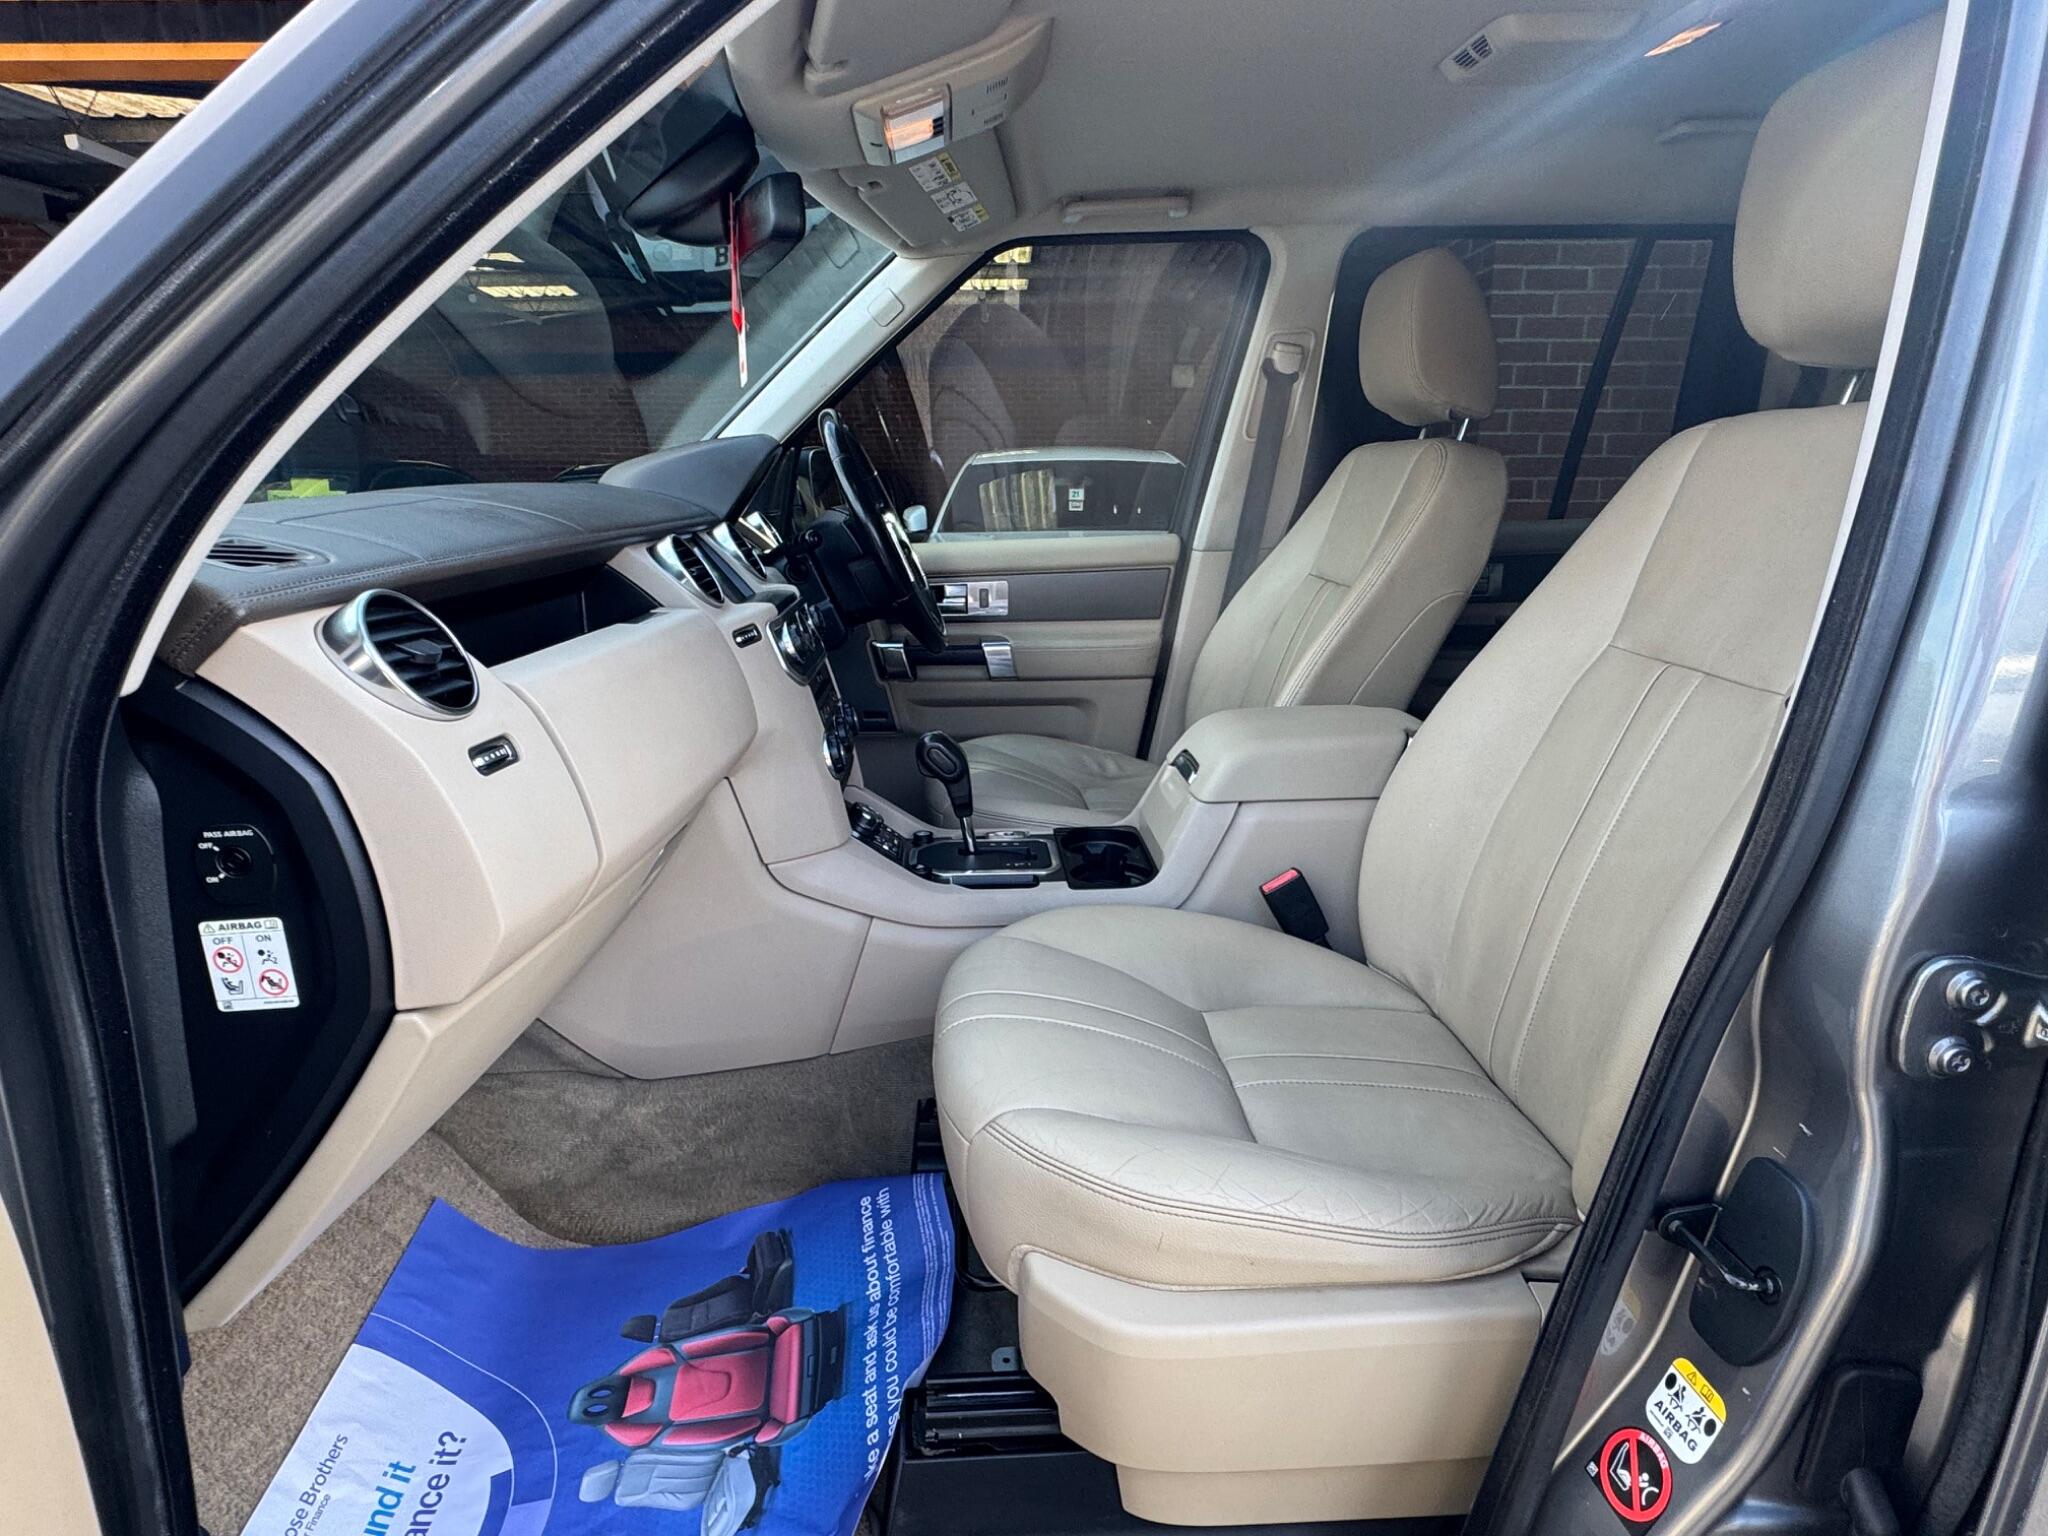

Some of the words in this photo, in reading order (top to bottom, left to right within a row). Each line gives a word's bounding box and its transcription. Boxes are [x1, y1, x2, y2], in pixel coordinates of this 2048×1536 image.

[223, 829, 254, 837] AIRBAG
[212, 937, 232, 945] OFF
[218, 921, 262, 932] AIRBAG
[255, 934, 271, 942] ON
[876, 1186, 892, 1219] with
[860, 1195, 876, 1254] finance
[863, 1252, 882, 1303] about
[881, 1218, 901, 1307] comfortable
[868, 1302, 881, 1321] us
[882, 1306, 898, 1330] be
[864, 1320, 879, 1350] ask
[882, 1327, 899, 1373] could
[863, 1350, 878, 1385] and
[862, 1384, 879, 1429] seat
[886, 1374, 902, 1412] you
[866, 1428, 880, 1446] a
[1654, 1400, 1698, 1452] AIRBAG
[428, 1431, 467, 1466] it?
[299, 1433, 348, 1507] Brothers
[382, 1461, 416, 1484] it
[305, 1494, 331, 1531] Finance
